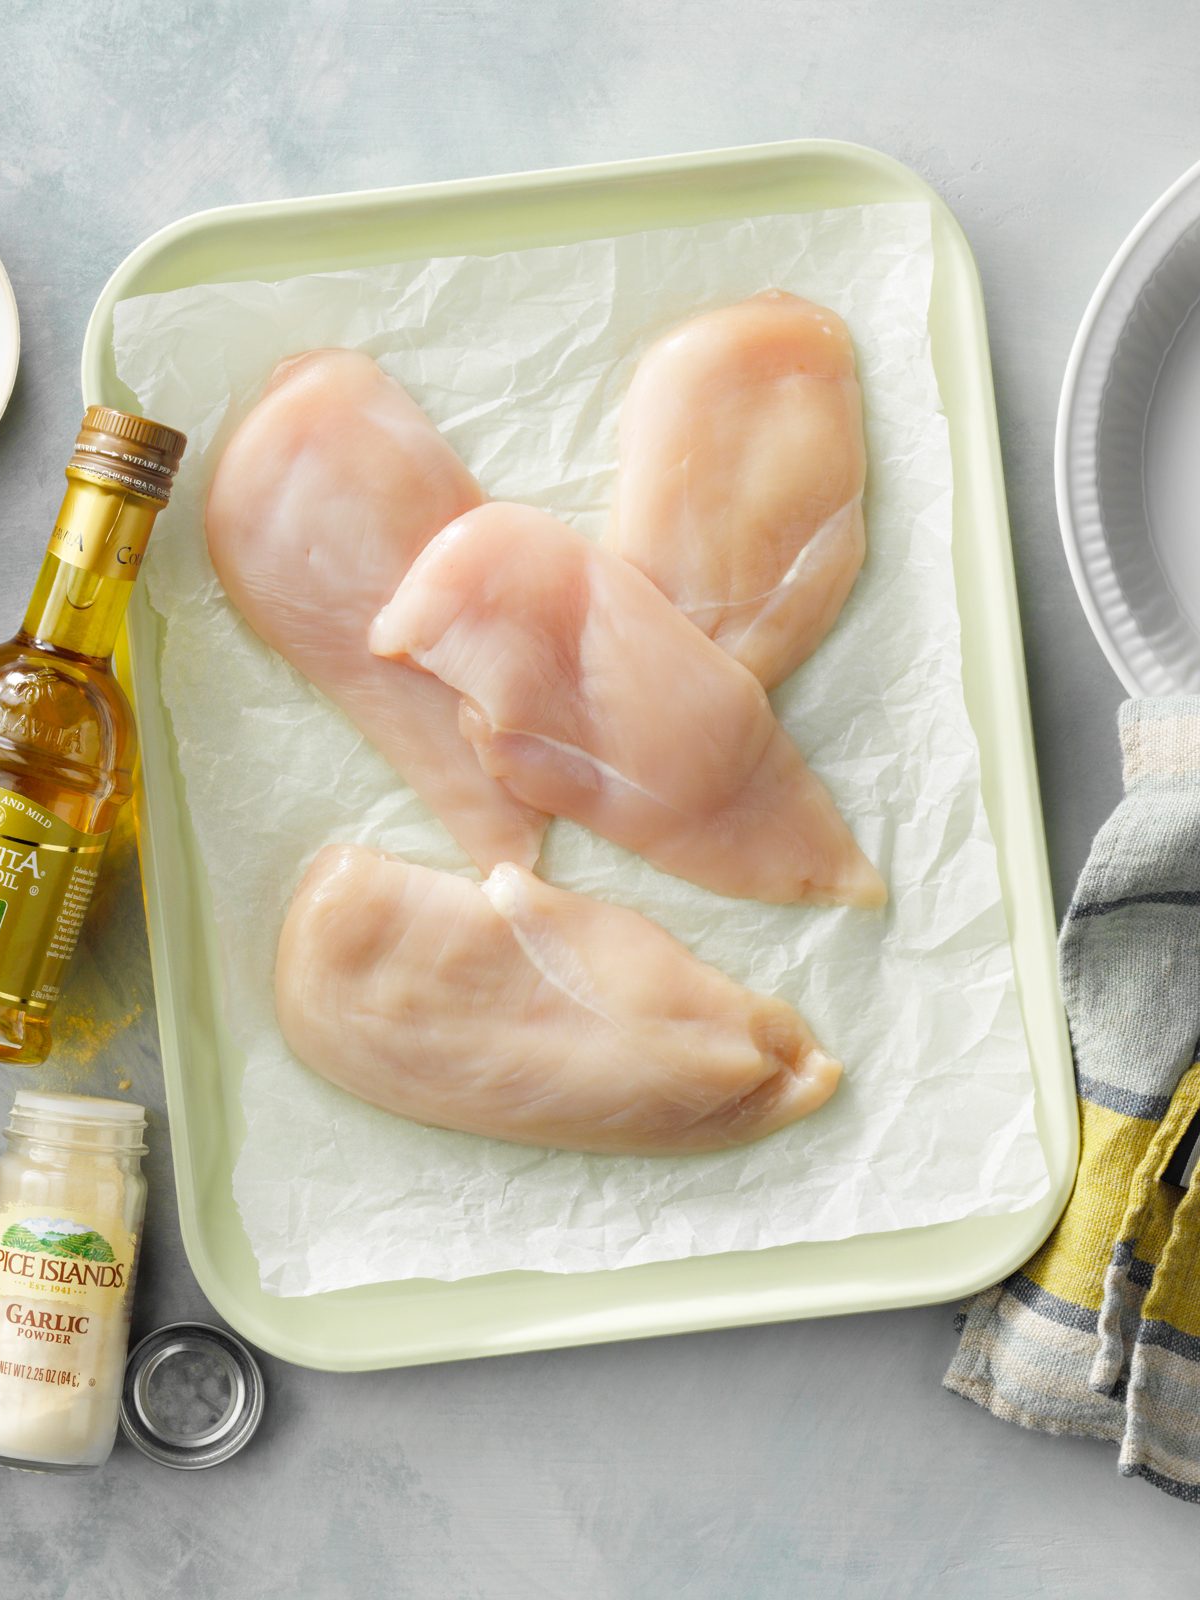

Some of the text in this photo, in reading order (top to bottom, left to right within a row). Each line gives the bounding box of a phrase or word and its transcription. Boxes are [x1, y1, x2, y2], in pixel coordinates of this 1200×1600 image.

[121, 453, 159, 470] SVITARE
[1, 796, 25, 812] AND
[25, 807, 53, 829] MILD
[39, 1258, 125, 1289] ISLANDS
[50, 1285, 71, 1295] 1941
[6, 1303, 90, 1335] GARLIC
[17, 1327, 71, 1345] POWDER
[0, 1360, 12, 1375] NET
[13, 1363, 26, 1378] WT
[26, 1366, 44, 1381] 2.25
[45, 1369, 57, 1384] OZ
[57, 1370, 71, 1386] (64
